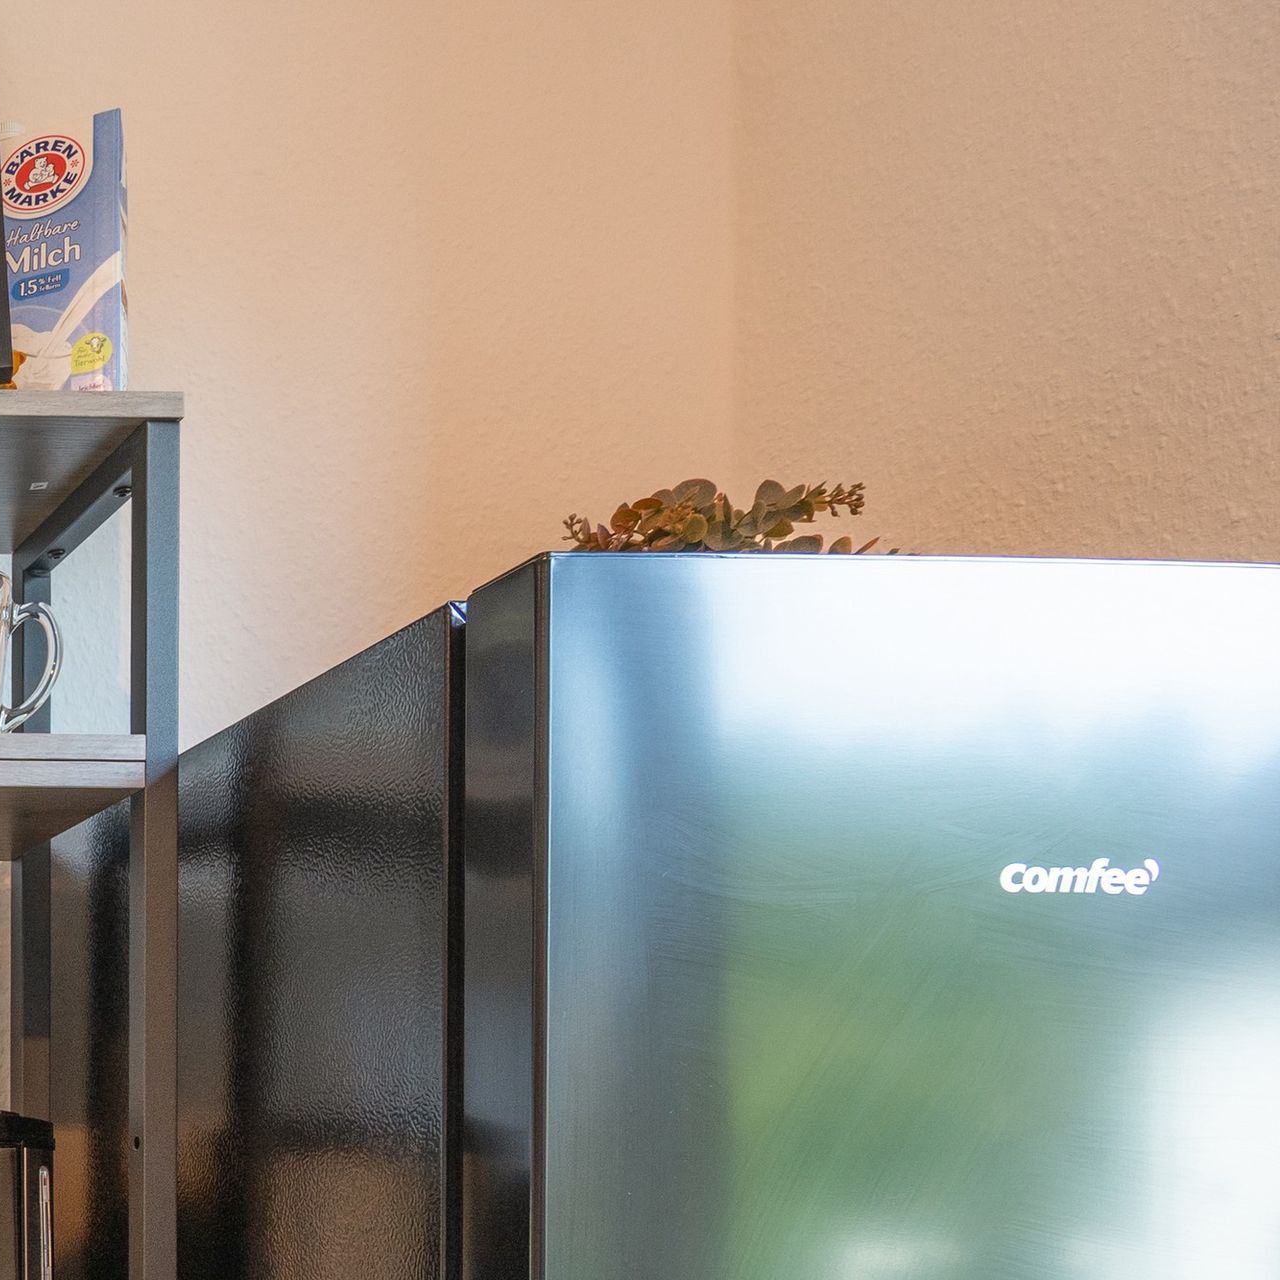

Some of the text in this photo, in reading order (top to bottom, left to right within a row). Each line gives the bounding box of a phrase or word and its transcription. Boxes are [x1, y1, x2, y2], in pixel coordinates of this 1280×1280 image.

[5, 140, 79, 175] BÄREN
[4, 171, 78, 207] MARKE
[6, 219, 80, 247] Haltbare
[6, 236, 81, 274] Milch
